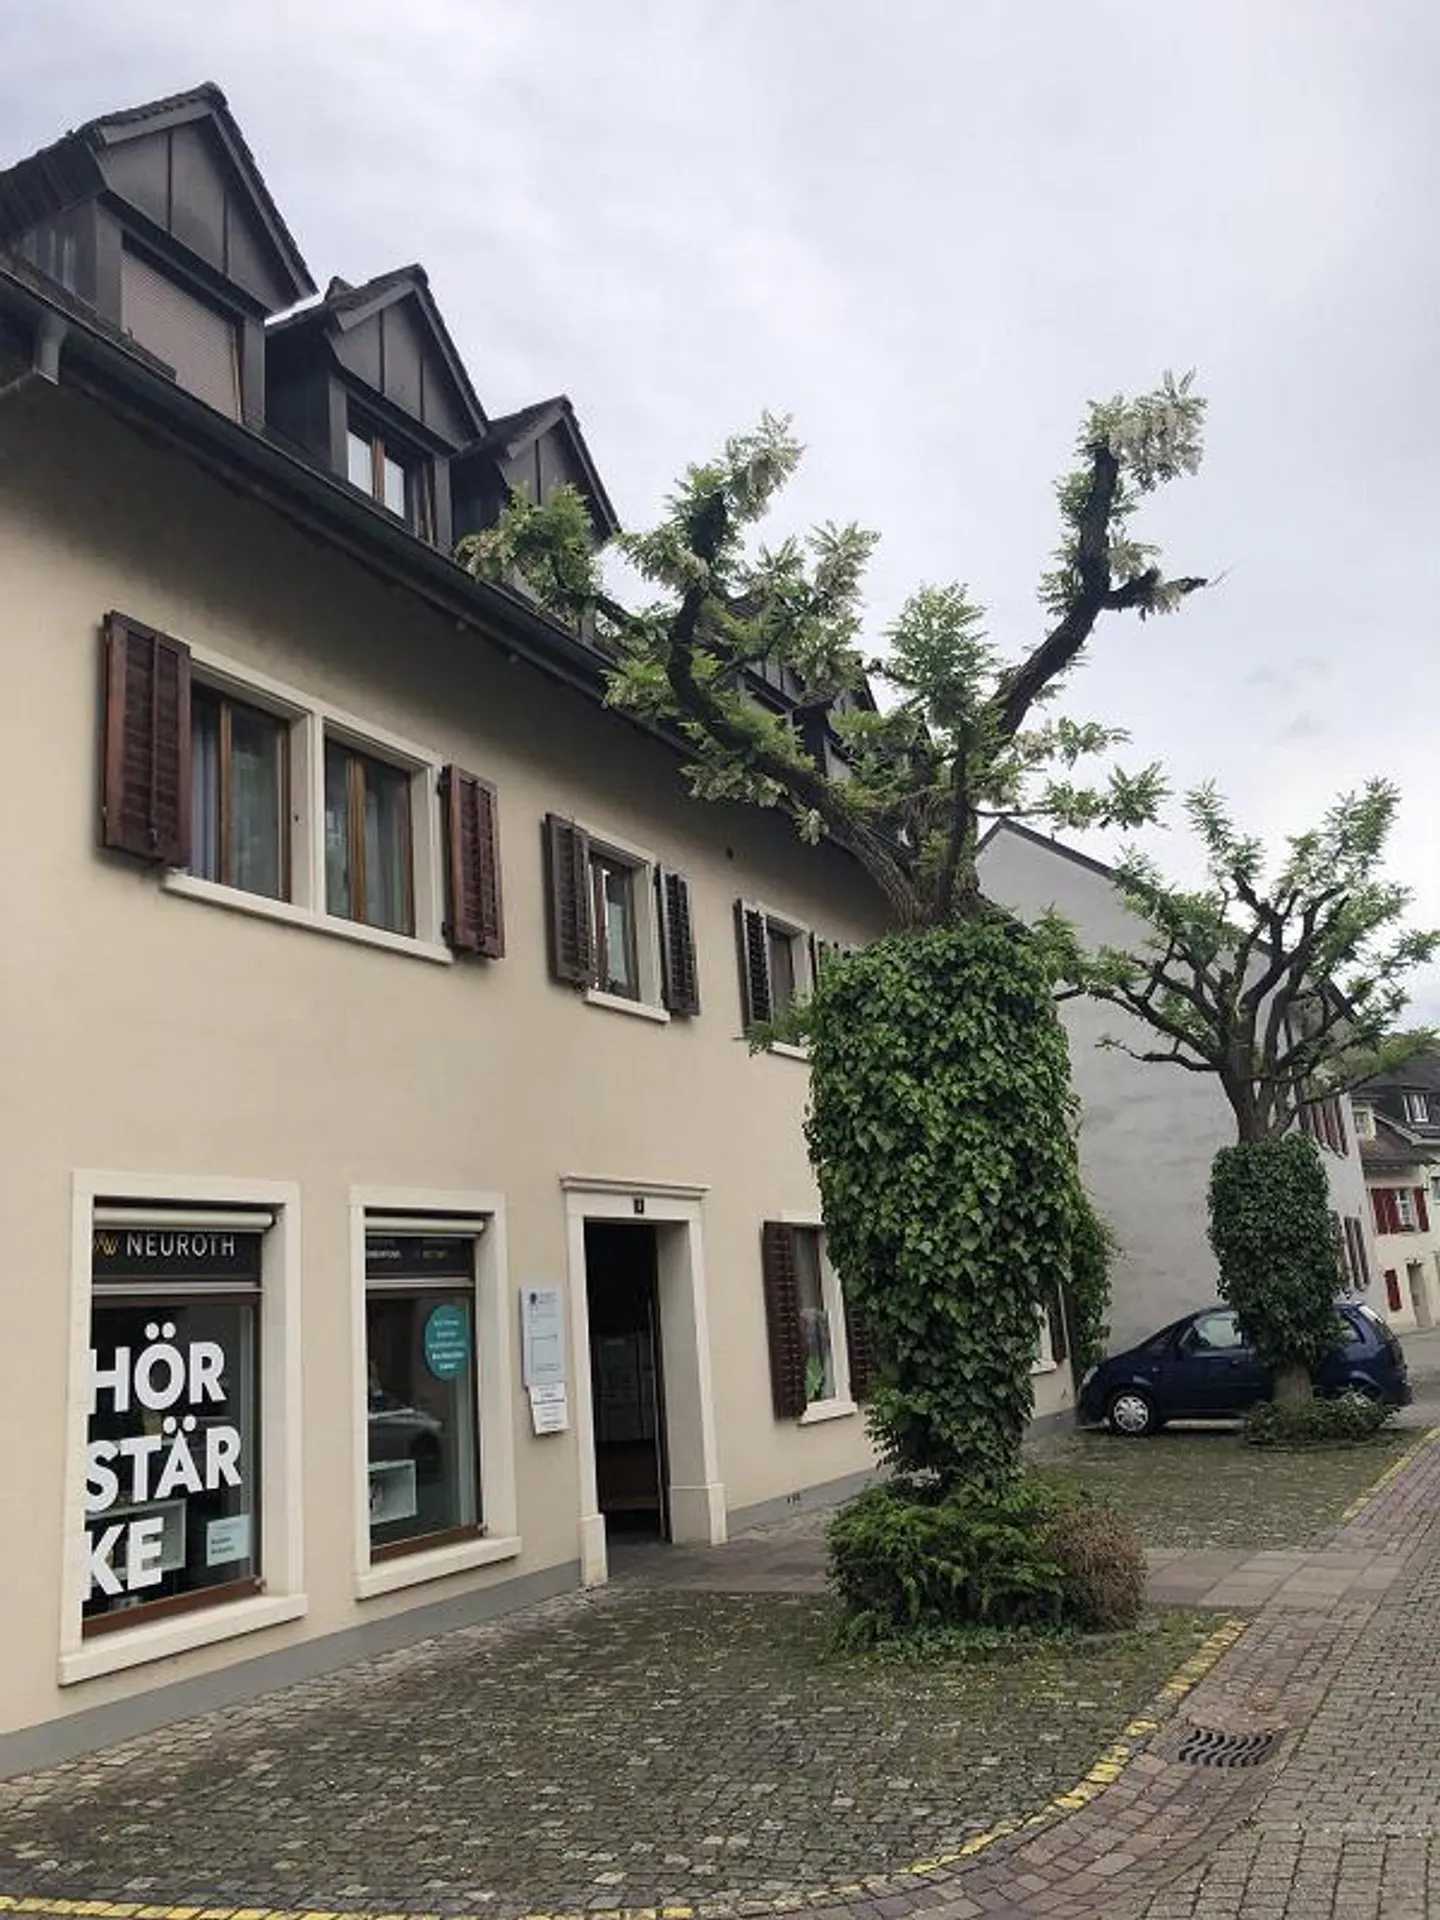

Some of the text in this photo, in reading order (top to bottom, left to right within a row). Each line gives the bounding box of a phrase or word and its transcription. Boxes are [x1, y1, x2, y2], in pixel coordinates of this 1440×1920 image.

[127, 1232, 235, 1256] NEUROTH
[87, 1322, 227, 1415] HÖR
[84, 1415, 243, 1513] STÄR
[78, 1516, 165, 1600] KE
